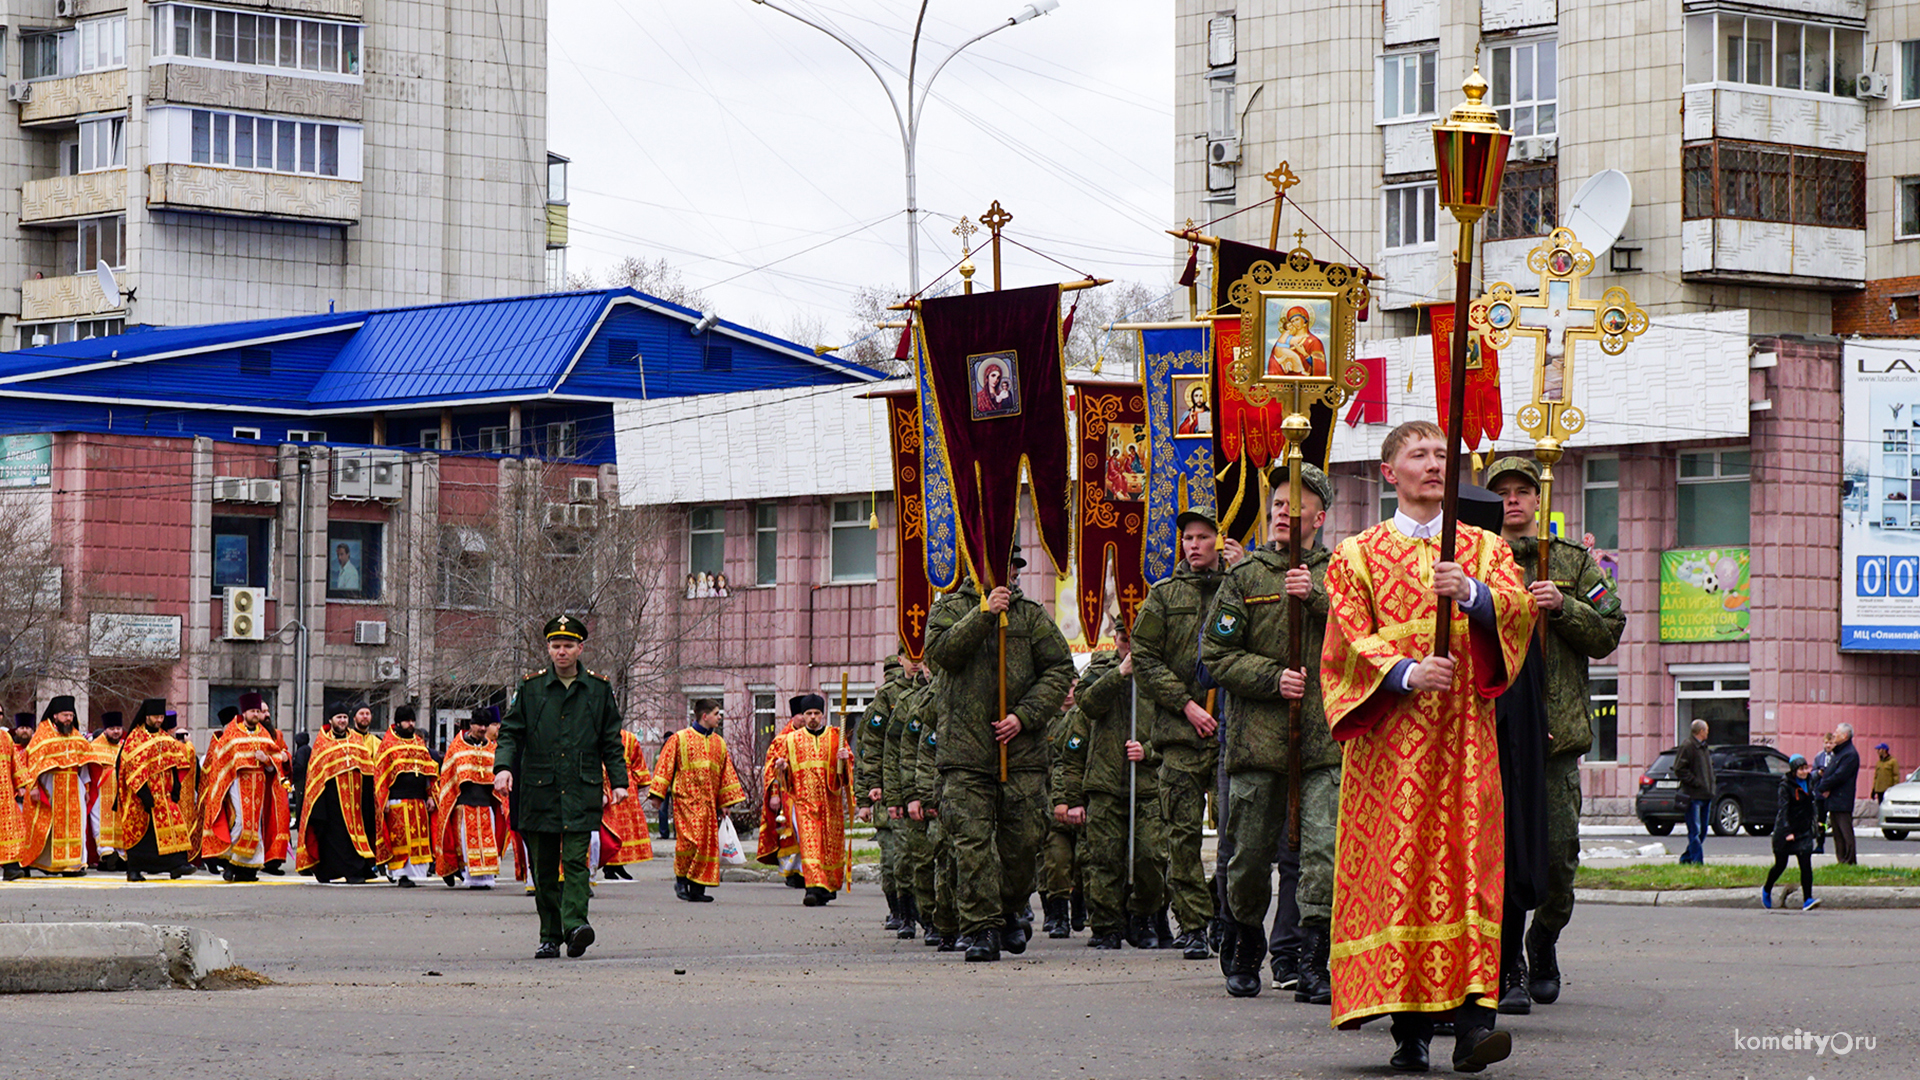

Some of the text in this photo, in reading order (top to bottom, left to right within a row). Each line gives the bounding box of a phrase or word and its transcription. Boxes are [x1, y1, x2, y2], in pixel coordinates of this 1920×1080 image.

[1858, 358, 1920, 373] LA
[6, 450, 37, 461] АРЕНДА
[1661, 582, 1681, 595] ВСЕ
[1662, 597, 1720, 610] ДЛЯ ИГРЫ
[1661, 612, 1738, 626] НА ОТКРЫТОМ
[1661, 626, 1716, 639] ВОЗДУХЕ
[1853, 630, 1870, 641] МЦ
